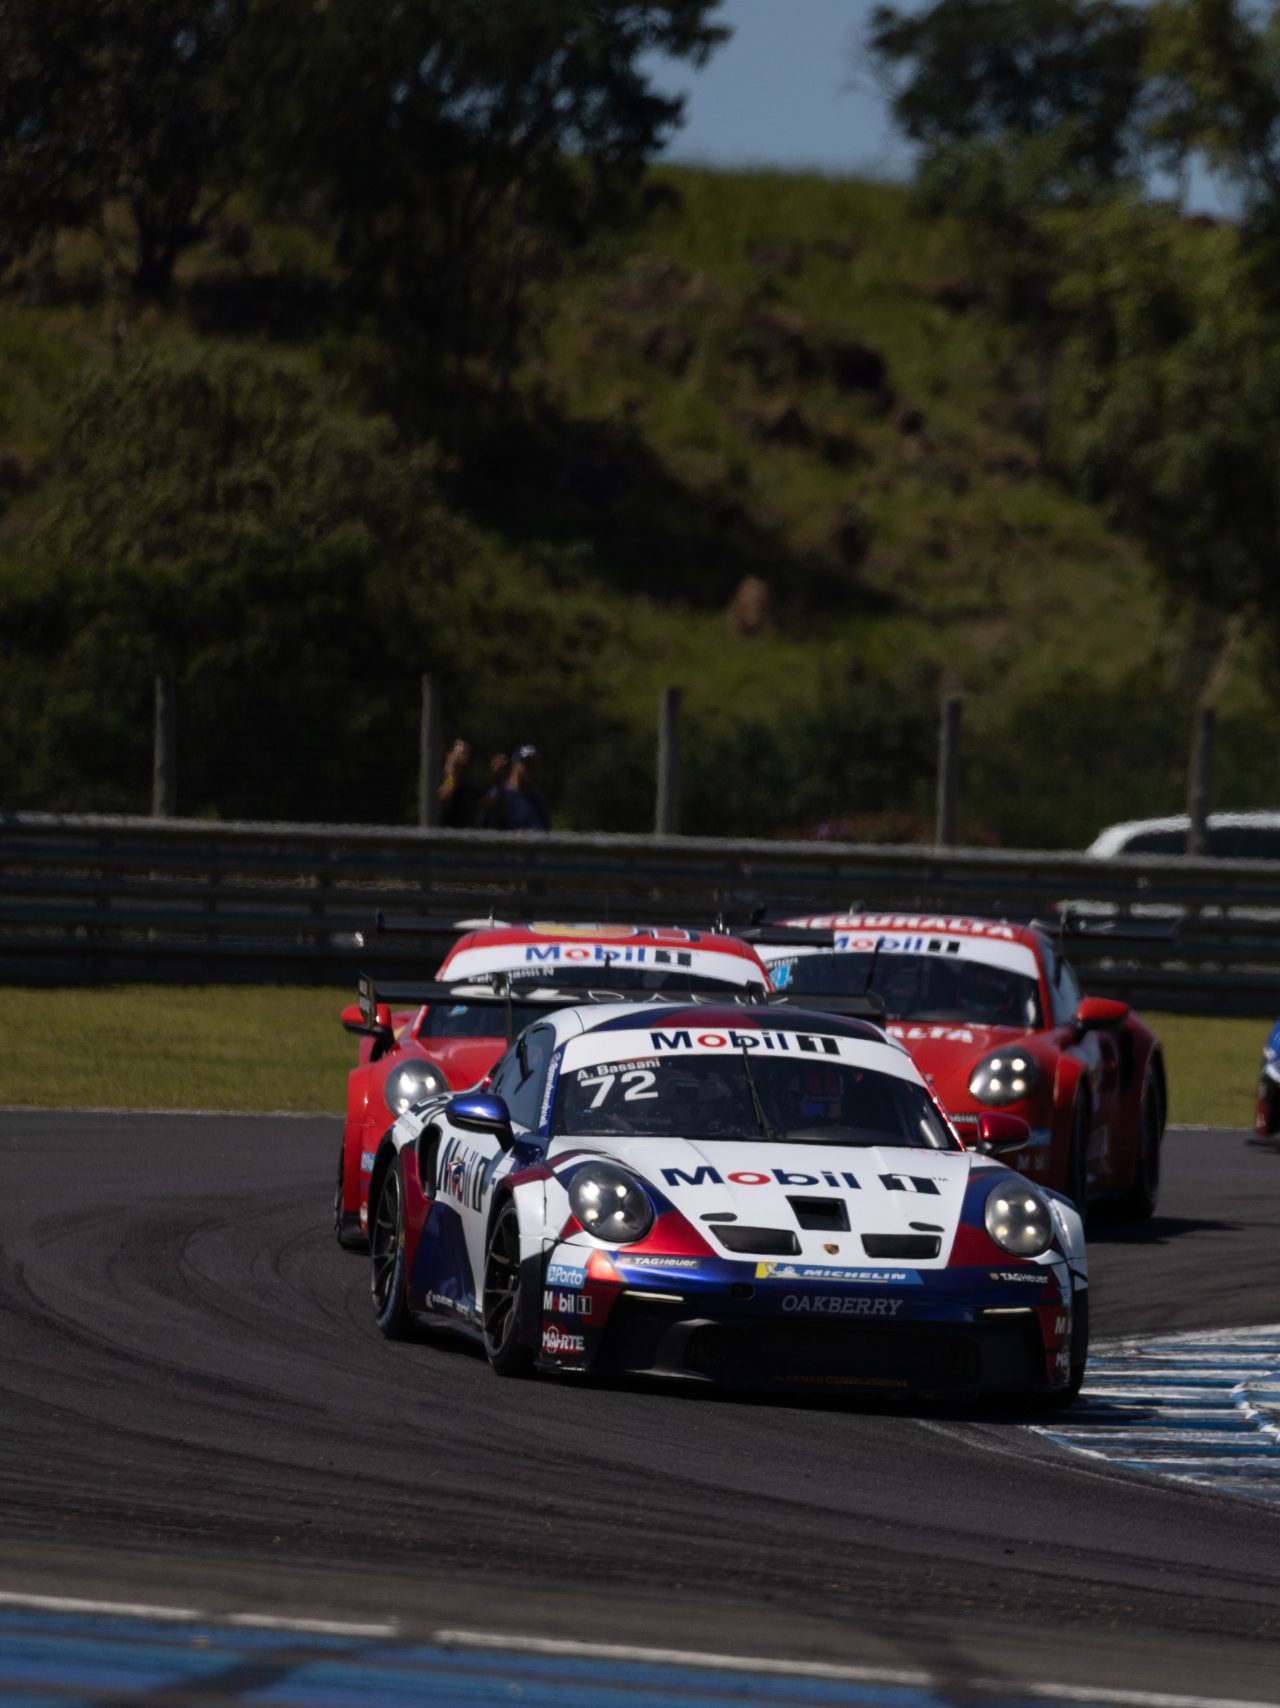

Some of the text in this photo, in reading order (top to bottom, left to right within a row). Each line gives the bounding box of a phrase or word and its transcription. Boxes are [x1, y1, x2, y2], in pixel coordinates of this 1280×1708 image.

[525, 946, 646, 963] Mobil
[650, 1030, 842, 1056] Mobil 1
[577, 1057, 662, 1082] A. Bassani
[580, 1069, 660, 1110] 72
[659, 1166, 863, 1190] Mobil
[877, 1172, 942, 1196] 1
[555, 1268, 584, 1286] Porto
[802, 1269, 907, 1281] MICHELIN
[542, 1289, 593, 1316] Mobil 1
[781, 1294, 905, 1317] OAKBERRY
